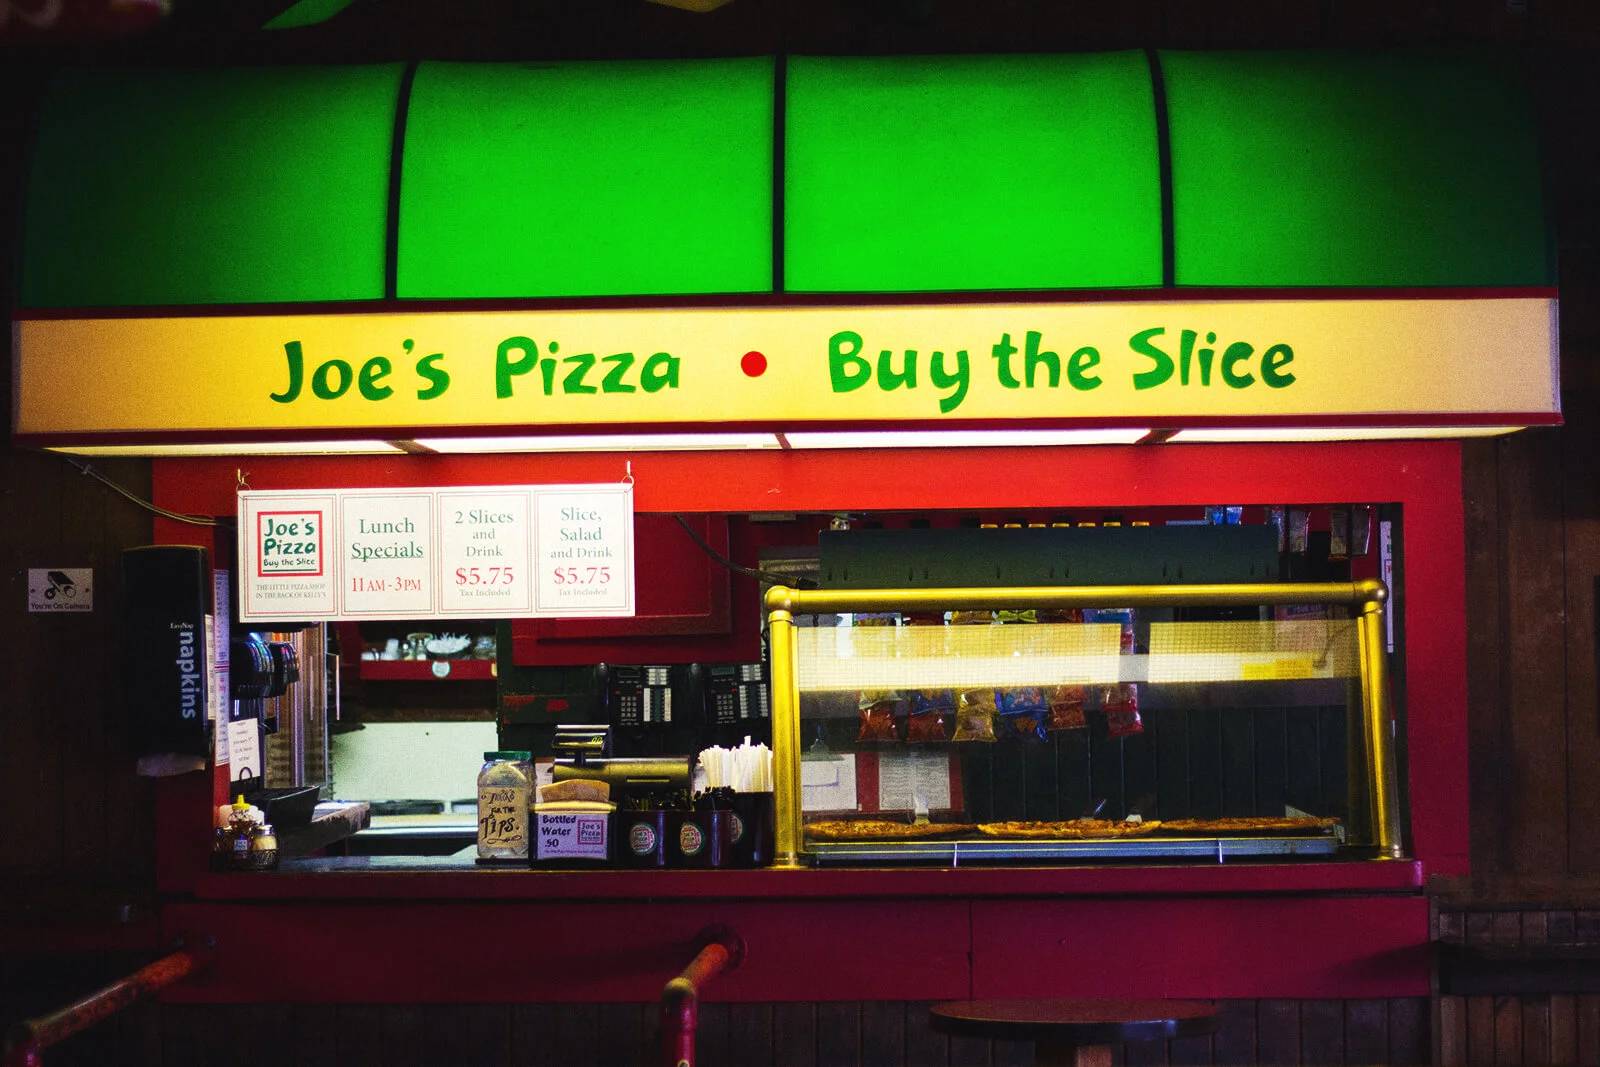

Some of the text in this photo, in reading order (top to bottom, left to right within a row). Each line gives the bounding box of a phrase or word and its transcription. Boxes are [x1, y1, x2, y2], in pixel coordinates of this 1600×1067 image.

[270, 326, 1296, 414] Joe's Pizza Buy the Slice
[454, 509, 514, 524] 2 Slices
[560, 507, 602, 522] Slice,
[263, 518, 315, 537] Joe's
[359, 517, 415, 534] Lunch
[472, 528, 496, 540] and
[560, 527, 603, 542] Salad
[263, 538, 316, 556] Pizza
[351, 541, 424, 562] Specials
[466, 546, 503, 557] Drink
[550, 547, 613, 558] and Drink
[263, 557, 315, 568] Buy the Slice
[455, 566, 514, 586] $5.75
[553, 566, 611, 585] $5.75
[460, 588, 511, 597] Tax Included
[176, 631, 200, 719] napkins
[542, 814, 577, 824] Bottled
[581, 822, 601, 830] Joe's
[541, 826, 572, 836] Water
[544, 838, 560, 848] .50
